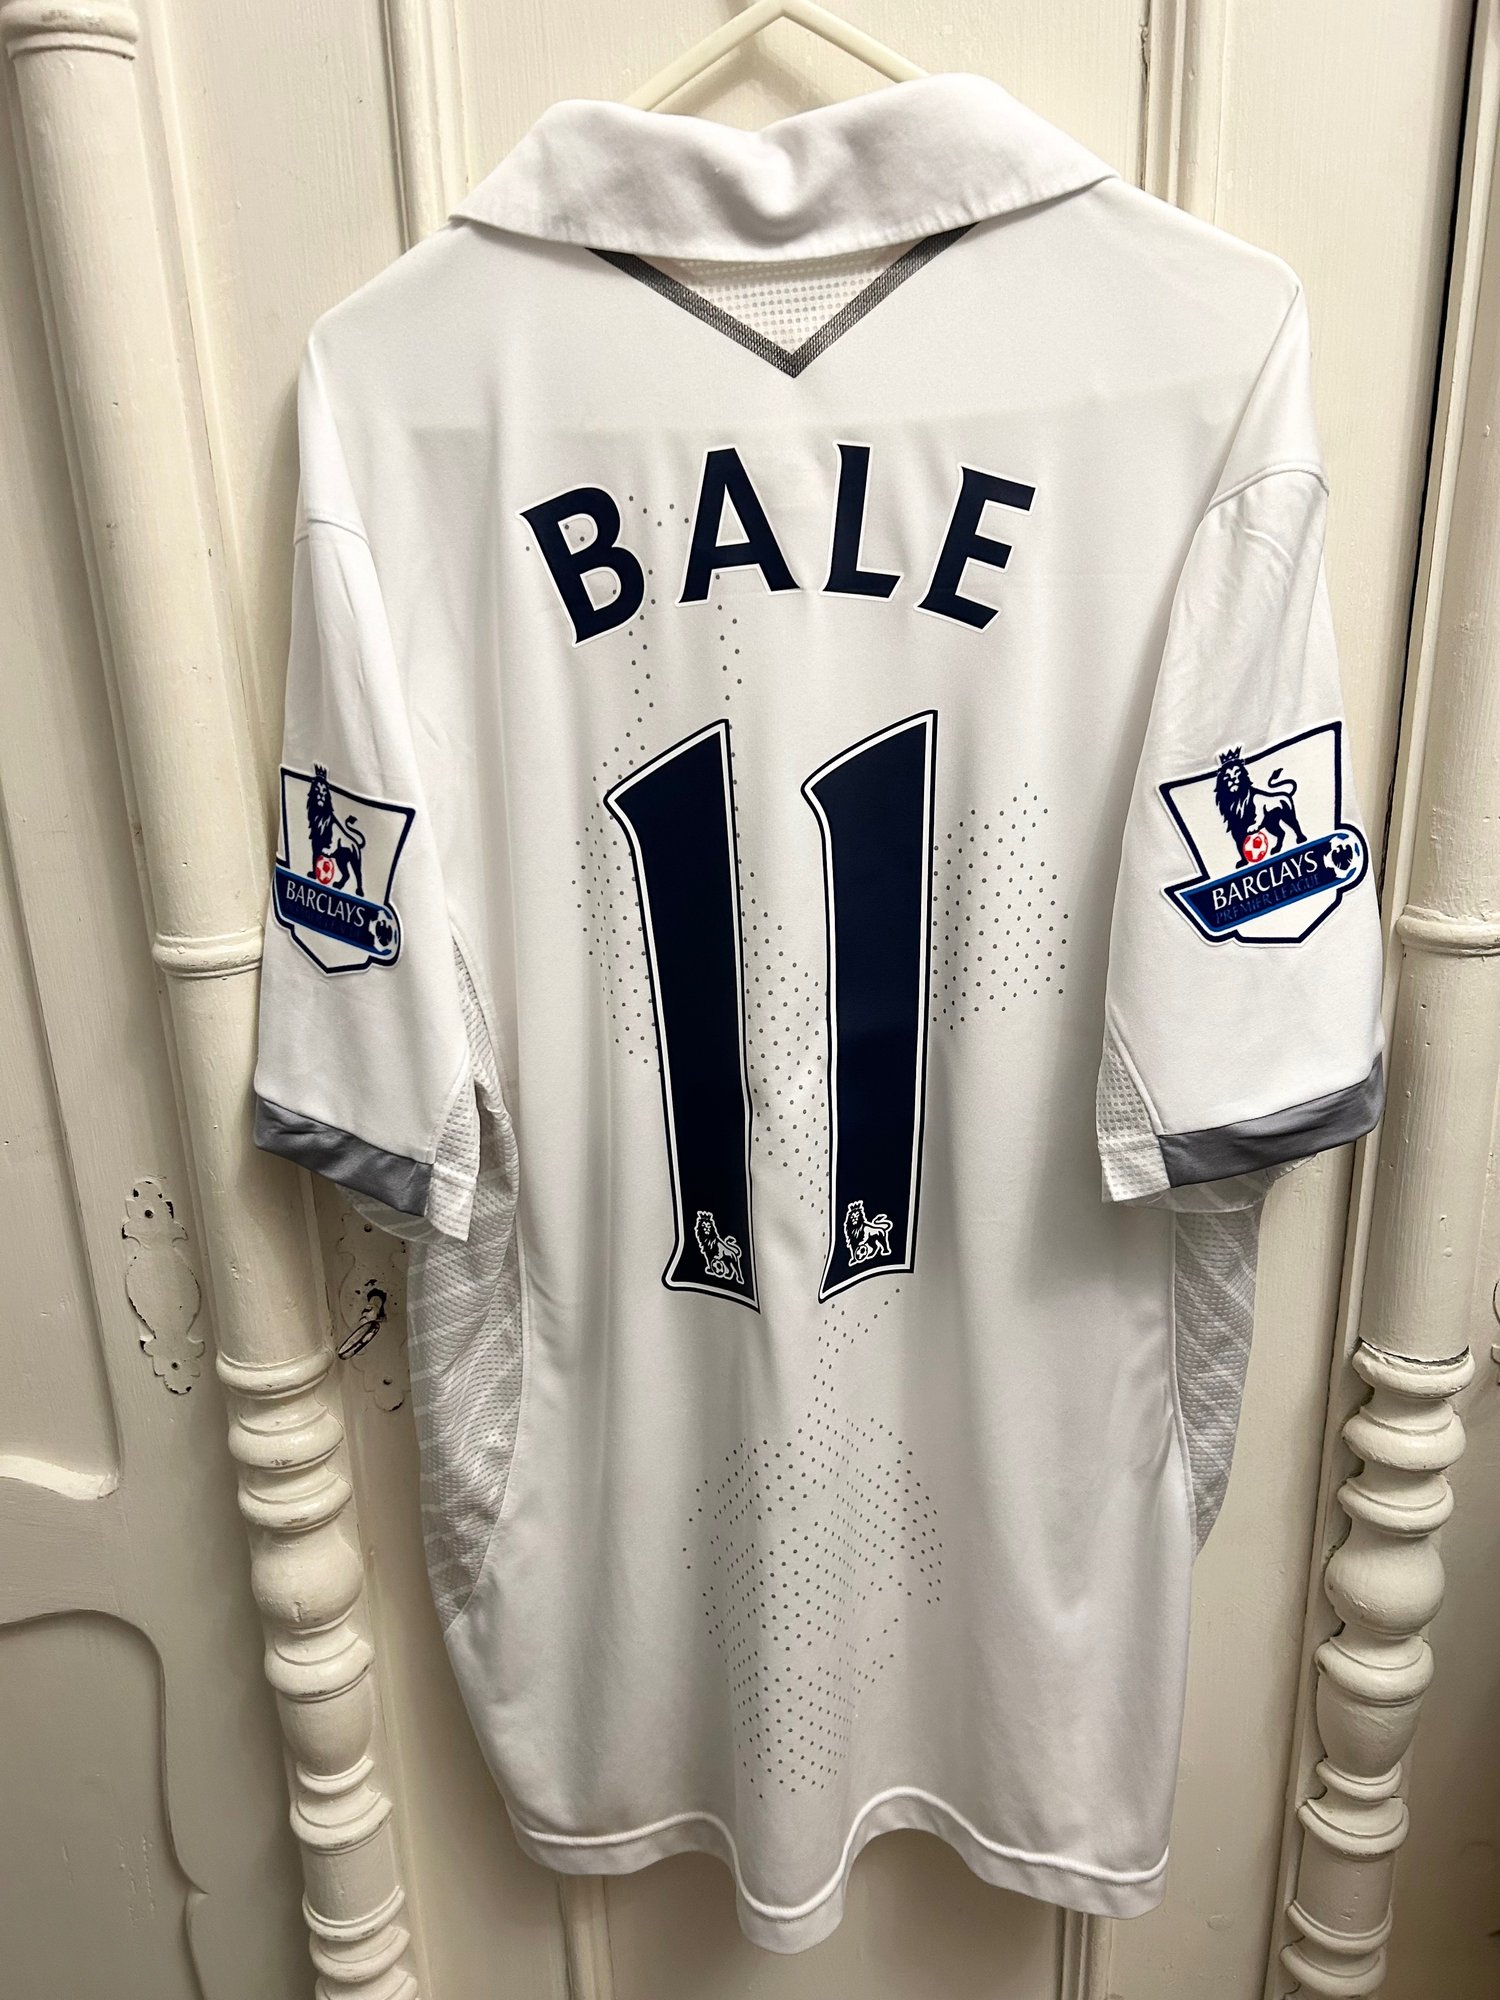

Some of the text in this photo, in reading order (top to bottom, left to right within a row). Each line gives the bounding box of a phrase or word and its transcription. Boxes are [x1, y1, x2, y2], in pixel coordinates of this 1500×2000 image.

[516, 443, 1037, 645] BALE
[285, 880, 366, 928] BARCLAYS
[1211, 850, 1319, 911] BARCLAYS
[1214, 873, 1321, 924] PREMIER LEAGUE
[602, 709, 939, 1314] 11
